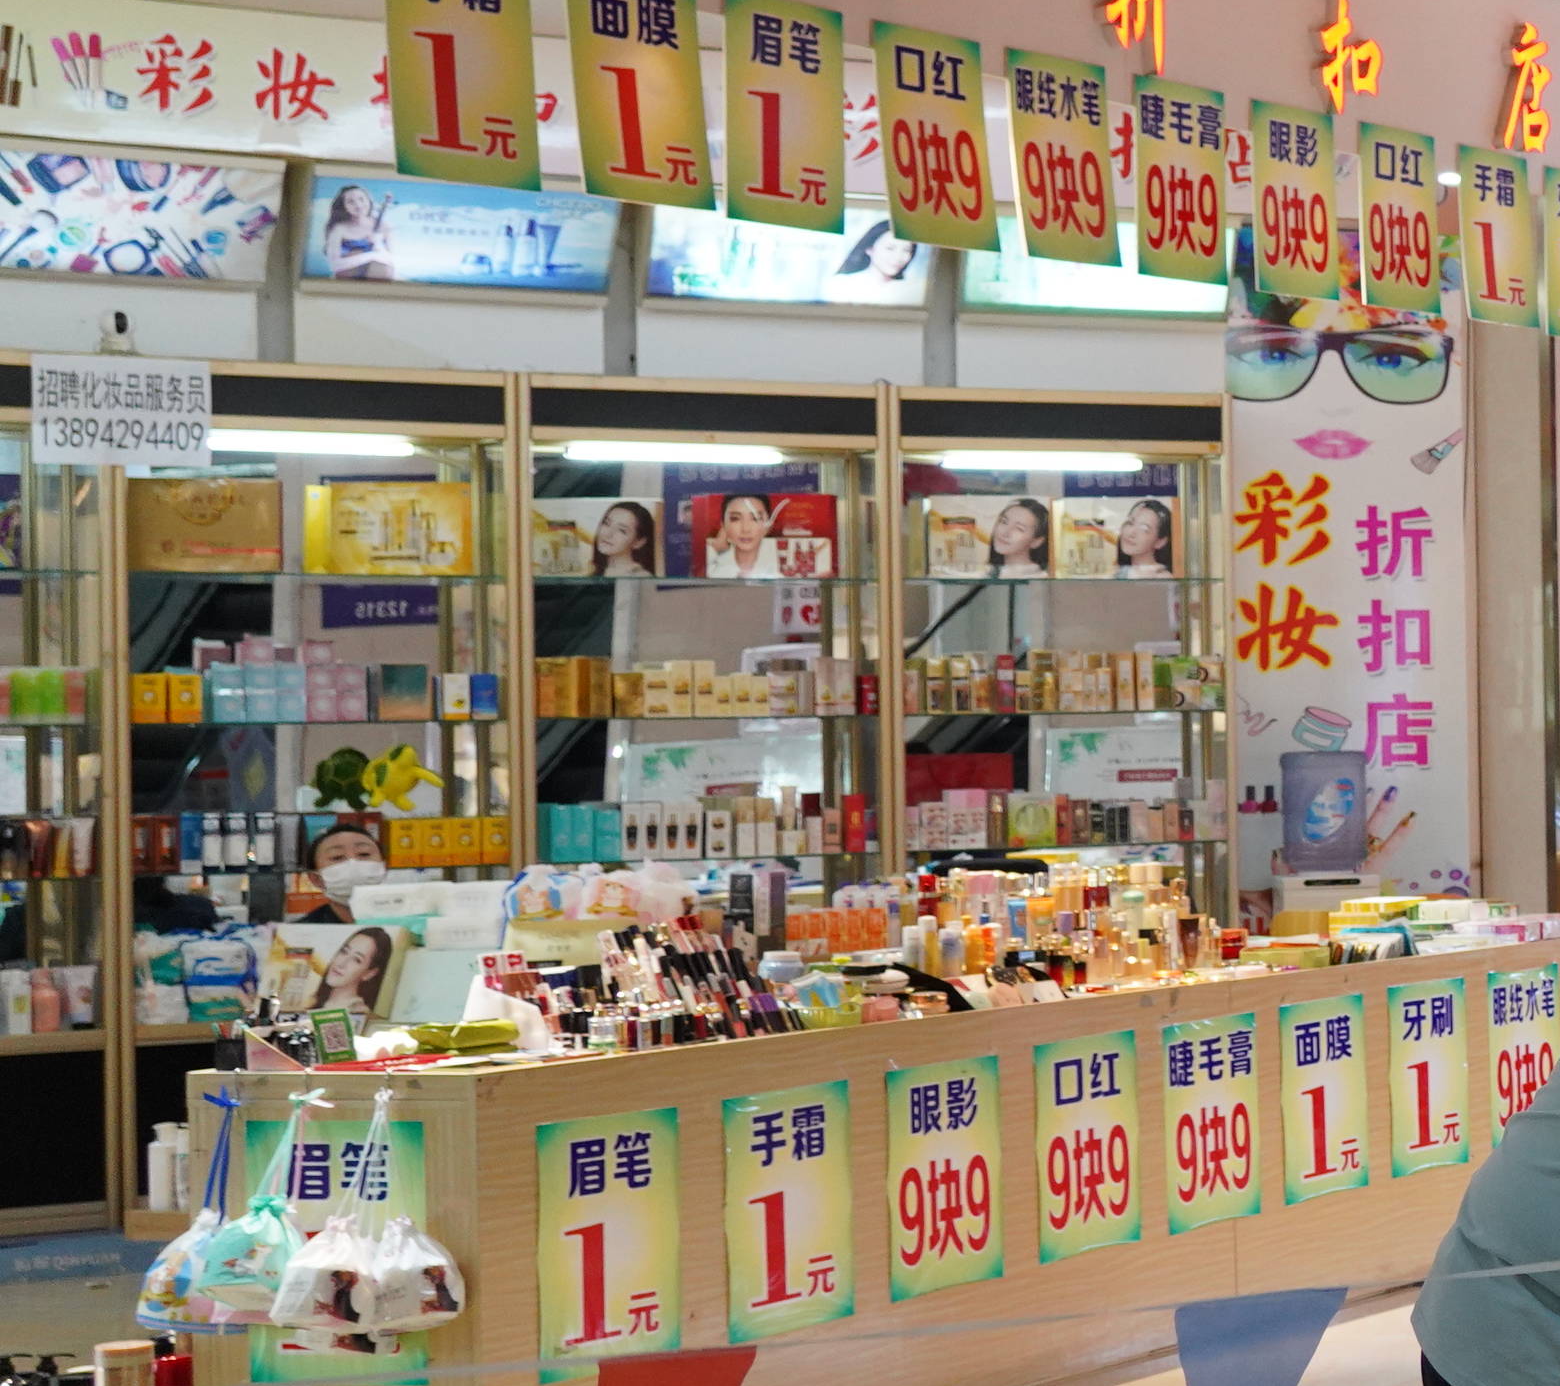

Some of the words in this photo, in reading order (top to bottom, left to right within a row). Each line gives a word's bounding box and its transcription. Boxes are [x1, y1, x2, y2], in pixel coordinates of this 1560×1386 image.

[750, 12, 822, 75] 眉笔
[894, 44, 967, 101] 口红
[413, 30, 518, 160] 1元
[599, 65, 699, 187] 1元
[1014, 66, 1102, 128] 眼线水笔
[1138, 92, 1223, 152] 睫毛膏
[746, 90, 828, 206] 1元
[891, 118, 983, 222] 9块9
[1268, 119, 1319, 168] 眼影
[1373, 140, 1425, 188] 口红
[1473, 163, 1516, 208] 手霜
[1022, 139, 1108, 239] 9块9
[1144, 163, 1219, 259] 9块9
[1261, 184, 1329, 274] 9块9
[1368, 203, 1432, 289] 9块9
[1473, 221, 1527, 307] 1元
[38, 369, 207, 413] 招聘化妆品服务员
[40, 416, 205, 452] 13894294409
[1235, 471, 1340, 673] 彩妆
[1355, 504, 1435, 769] 折扣店
[1294, 1014, 1353, 1067] 面膜
[1401, 996, 1455, 1042] 牙刷
[1492, 977, 1556, 1027] 眼线水笔
[1053, 1050, 1121, 1107] 口红
[1167, 1029, 1254, 1089] 睫毛膏
[750, 1103, 826, 1167] 手霜
[909, 1076, 979, 1135] 眼影
[1301, 1085, 1361, 1181] 1元
[1406, 1060, 1462, 1151] 1元
[568, 1131, 653, 1198] 眉笔
[1046, 1123, 1131, 1231] 9块9
[1174, 1101, 1253, 1203] 9块9
[747, 1190, 836, 1309] 1元
[898, 1154, 991, 1268] 9块9
[563, 1222, 660, 1348] 1元
